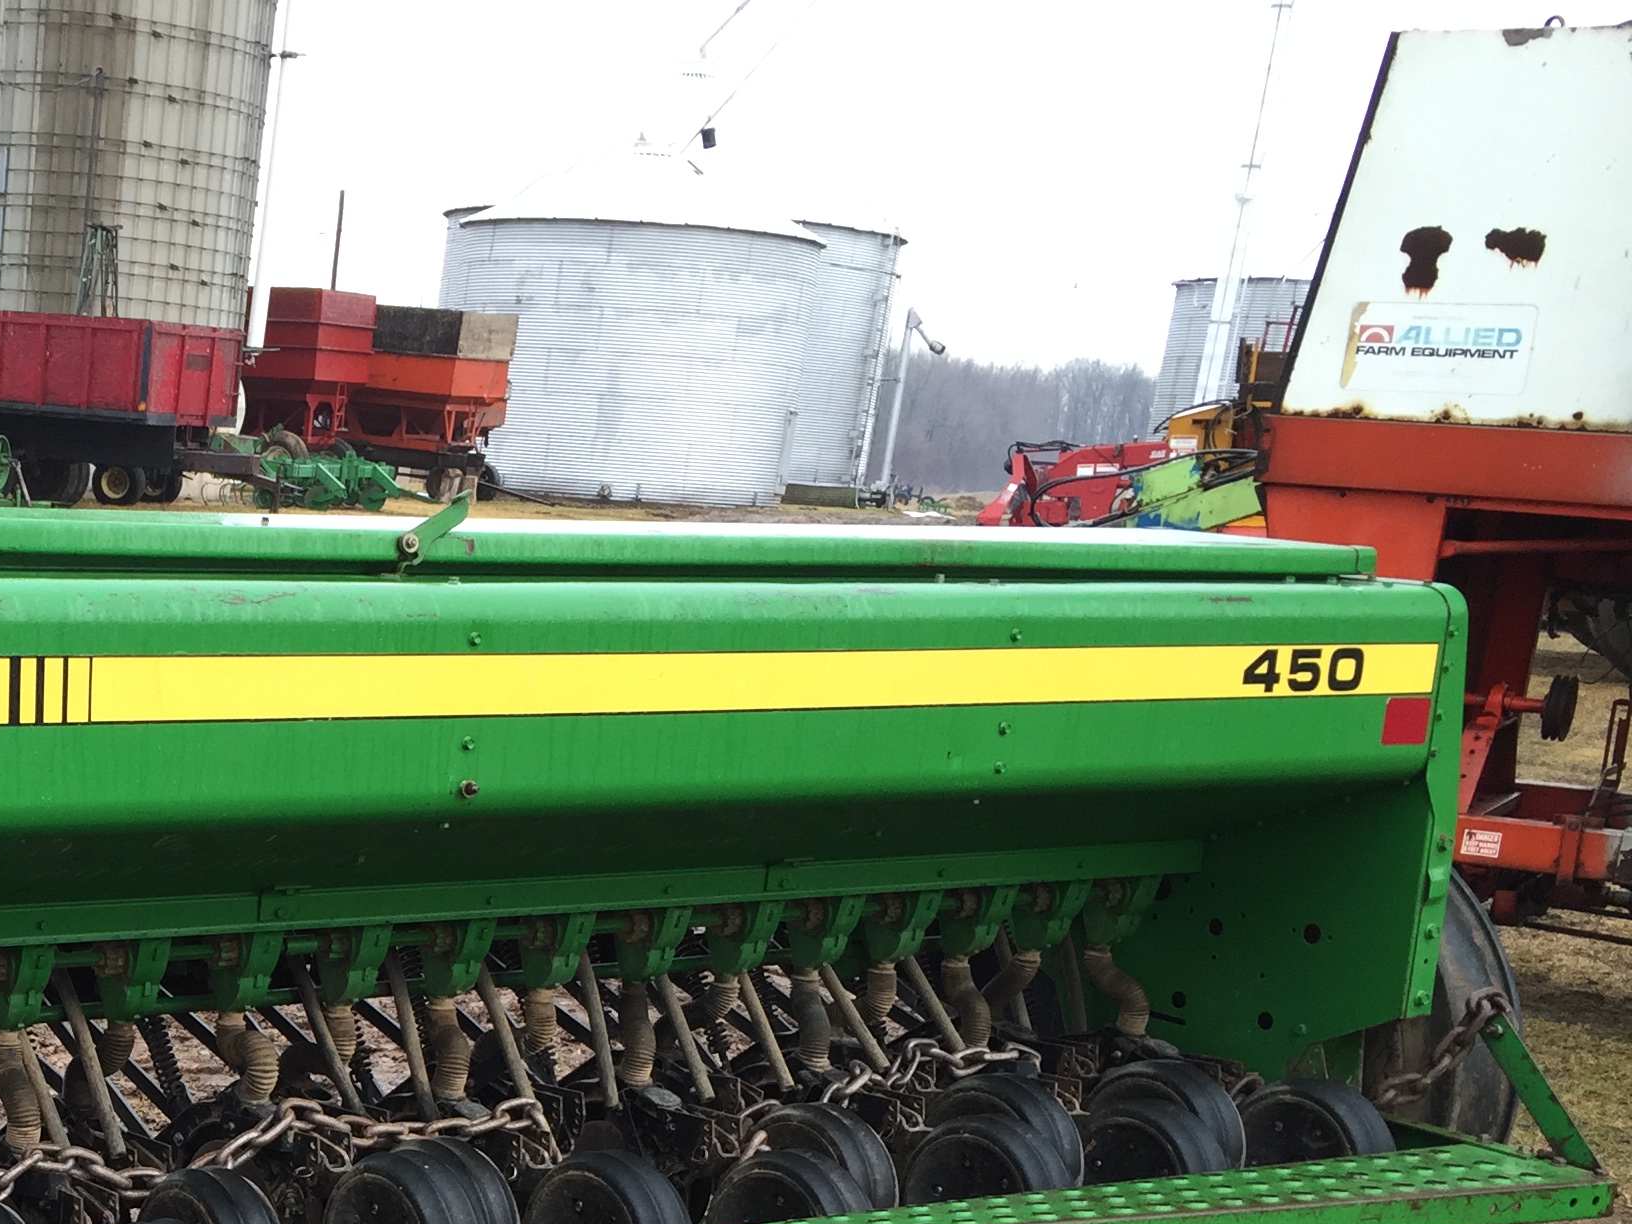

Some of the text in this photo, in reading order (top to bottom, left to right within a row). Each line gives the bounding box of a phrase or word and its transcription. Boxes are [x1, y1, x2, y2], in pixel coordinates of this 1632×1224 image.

[1396, 325, 1522, 347] ALLIED
[1355, 346, 1519, 359] FARM EQUIPMENT
[1242, 647, 1365, 693] 450
